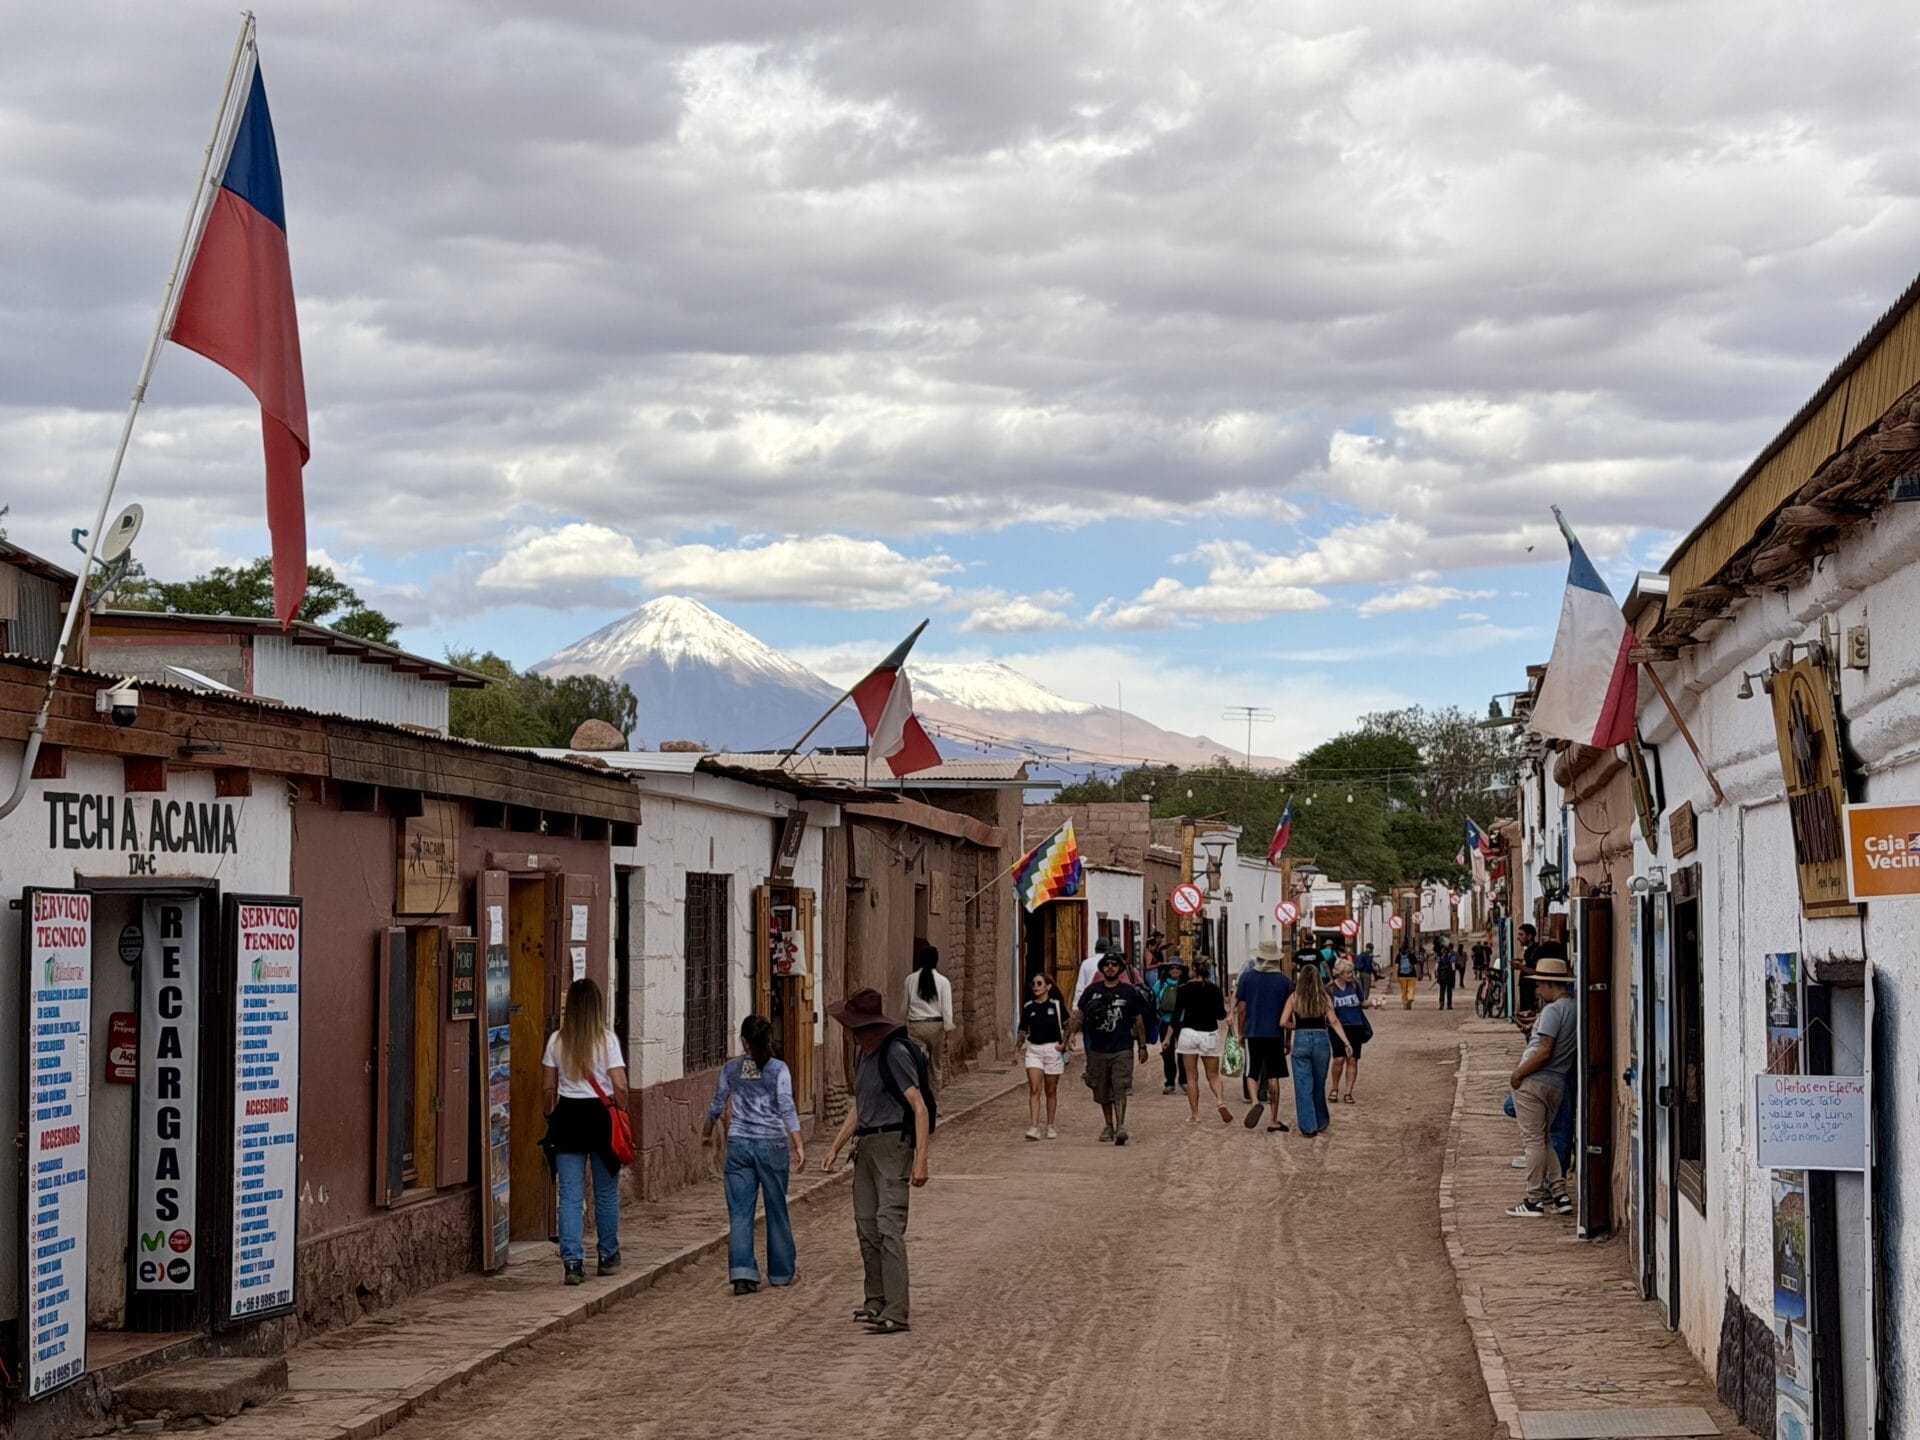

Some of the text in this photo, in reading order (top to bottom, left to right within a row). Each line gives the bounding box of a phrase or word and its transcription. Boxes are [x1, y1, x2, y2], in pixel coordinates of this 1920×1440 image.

[43, 791, 115, 851] TECH
[150, 799, 238, 855] ACAMA
[1864, 834, 1906, 855] Caja
[240, 907, 298, 931] SERVICIO
[37, 926, 87, 948] TECNICO
[243, 932, 295, 951] TECNICO
[155, 906, 183, 1222] RECARGAS
[1776, 1077, 1811, 1096] Ofertas
[1813, 1084, 1827, 1092] en
[245, 1097, 288, 1116] ACCESORIOS
[40, 1124, 80, 1151] ACCESORIOS
